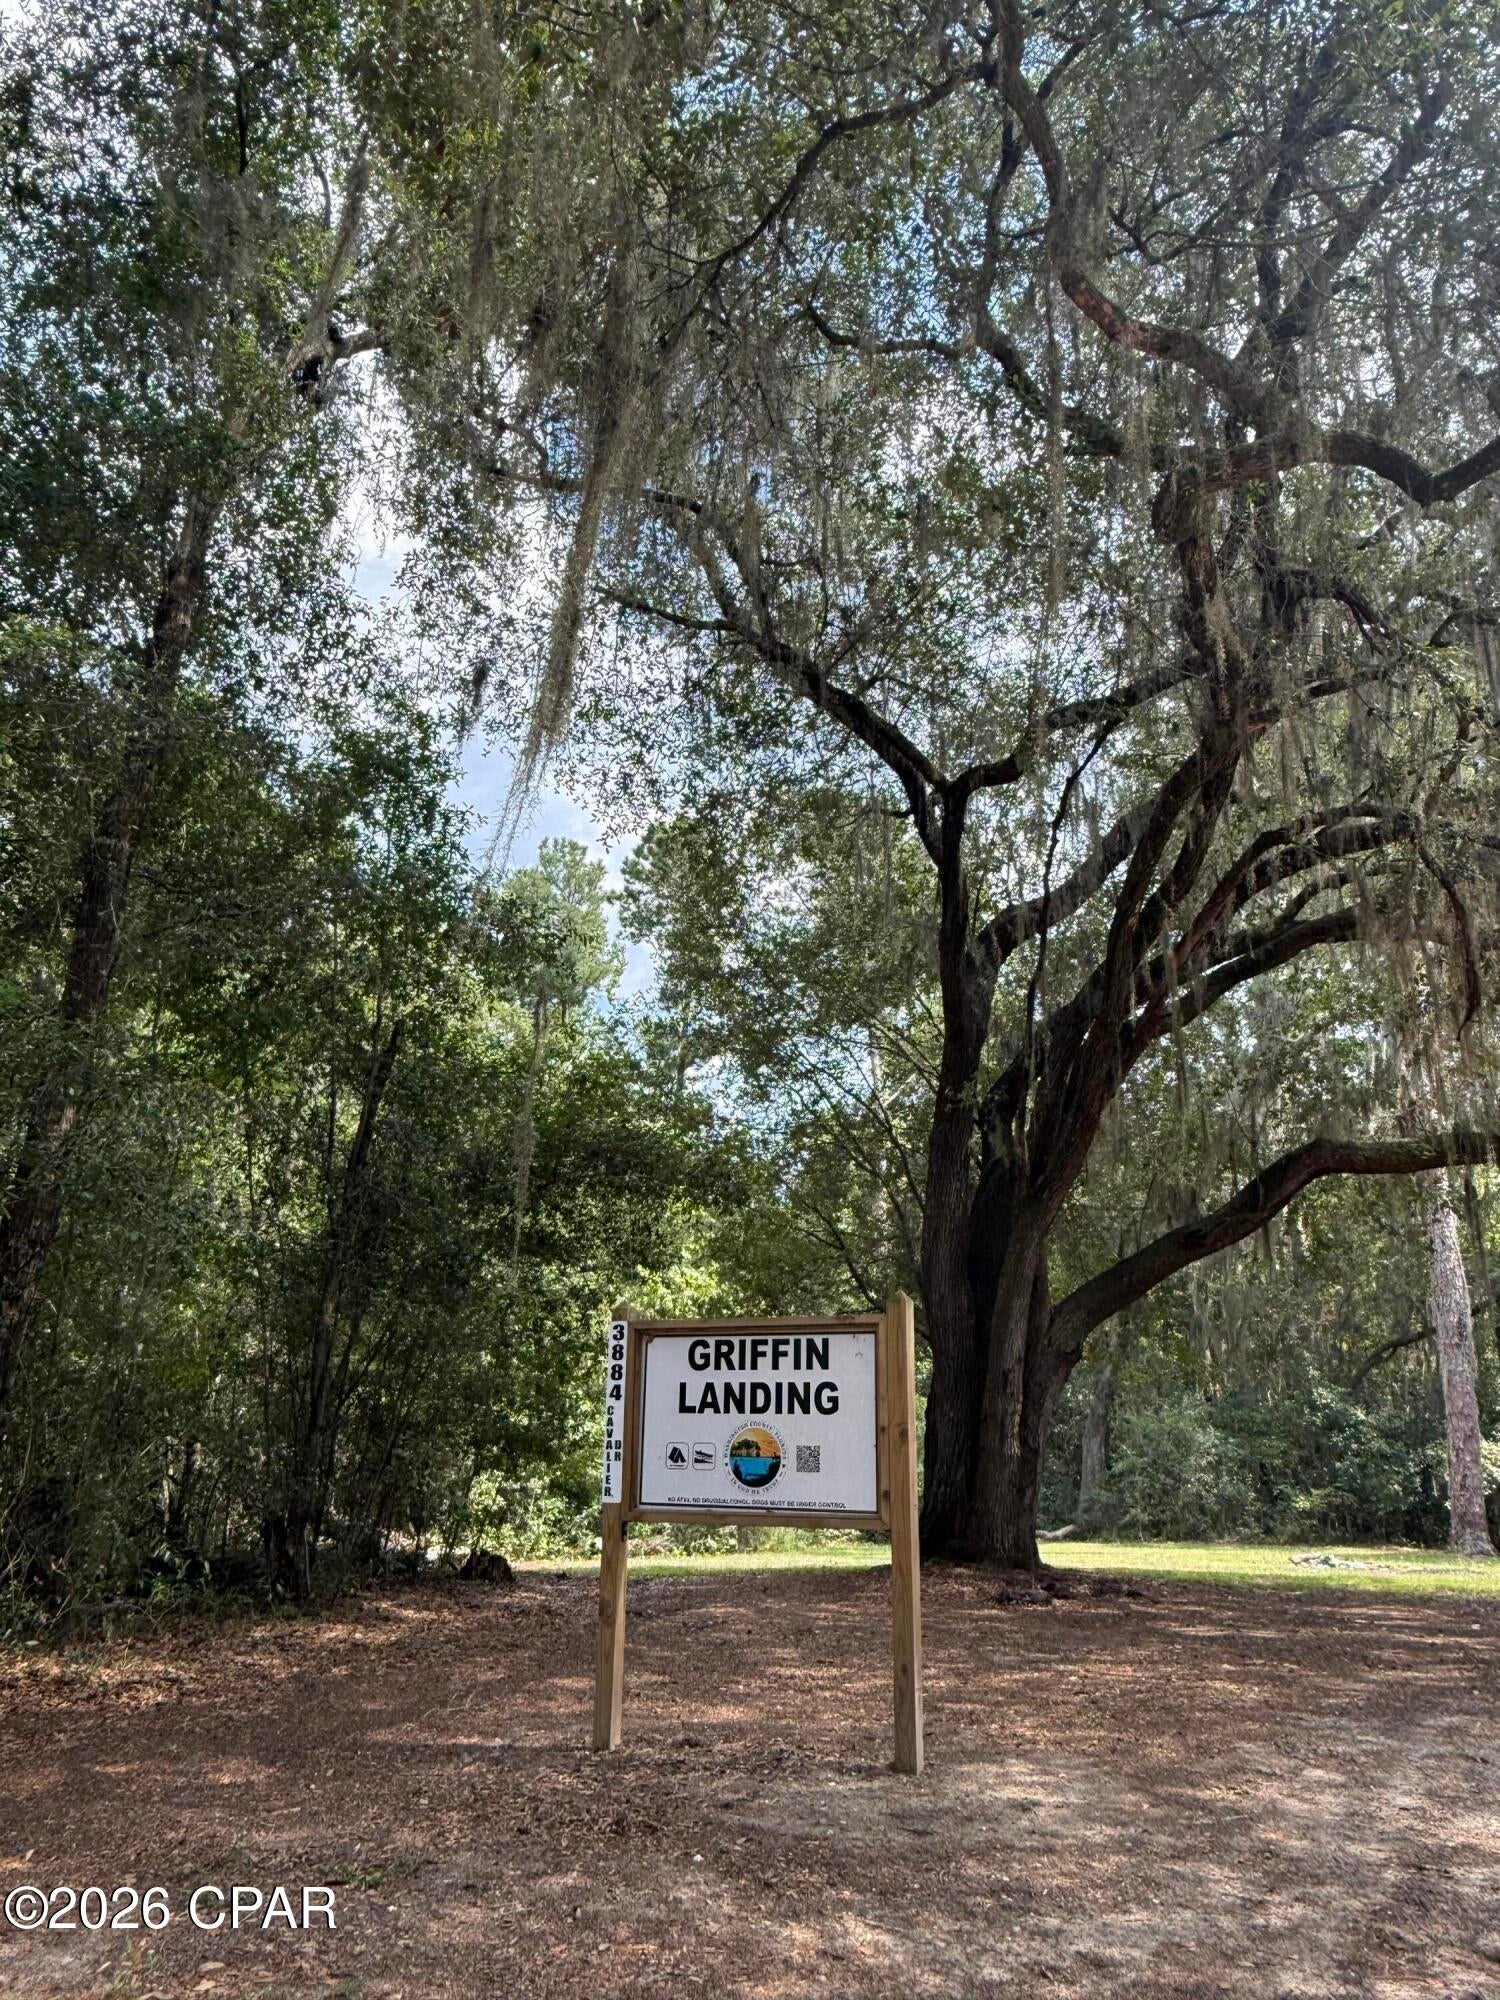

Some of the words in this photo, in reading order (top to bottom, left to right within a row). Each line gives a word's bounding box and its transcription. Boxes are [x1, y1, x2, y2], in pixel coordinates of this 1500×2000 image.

[609, 1324, 625, 1401] 3884
[688, 1338, 830, 1371] GRIFFIN
[679, 1381, 839, 1415] LANDING
[604, 1405, 614, 1497] CAVALIER
[614, 1440, 622, 1462] DR
